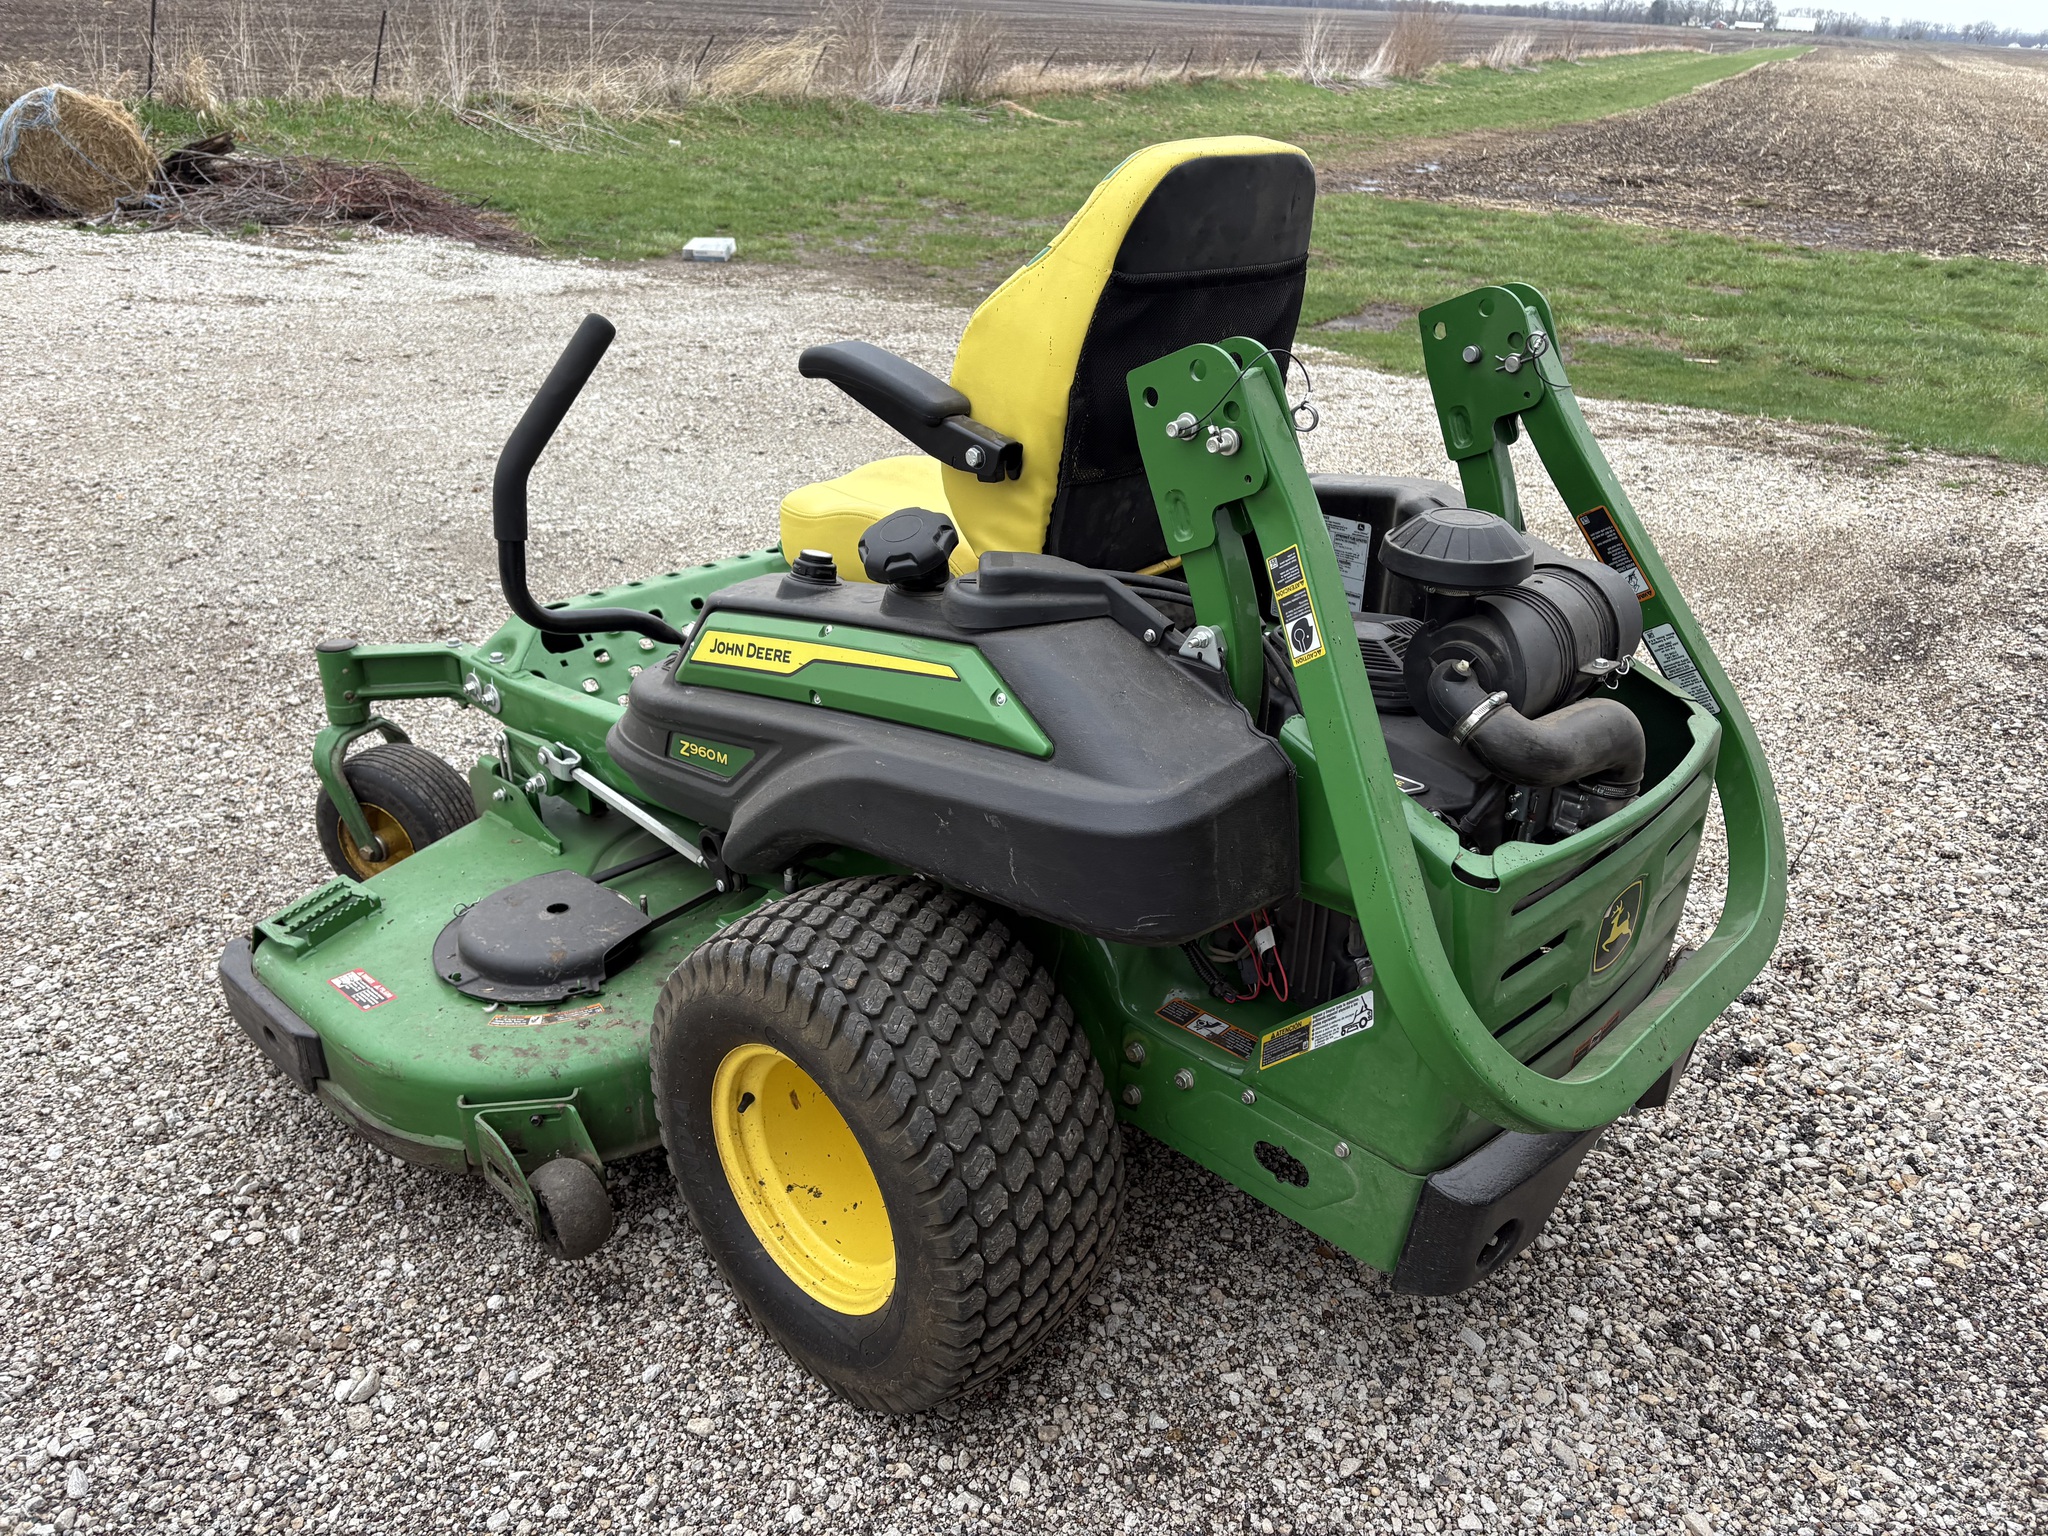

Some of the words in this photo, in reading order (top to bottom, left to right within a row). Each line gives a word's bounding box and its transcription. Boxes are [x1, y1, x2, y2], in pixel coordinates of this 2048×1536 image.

[1276, 582, 1301, 599] ATENCIÓN
[709, 638, 744, 657] JOHN
[746, 642, 792, 664] DEERE
[1295, 651, 1318, 665] CAUTION
[679, 740, 728, 765] Z960M
[1276, 1021, 1303, 1037] ATENCIÓN
